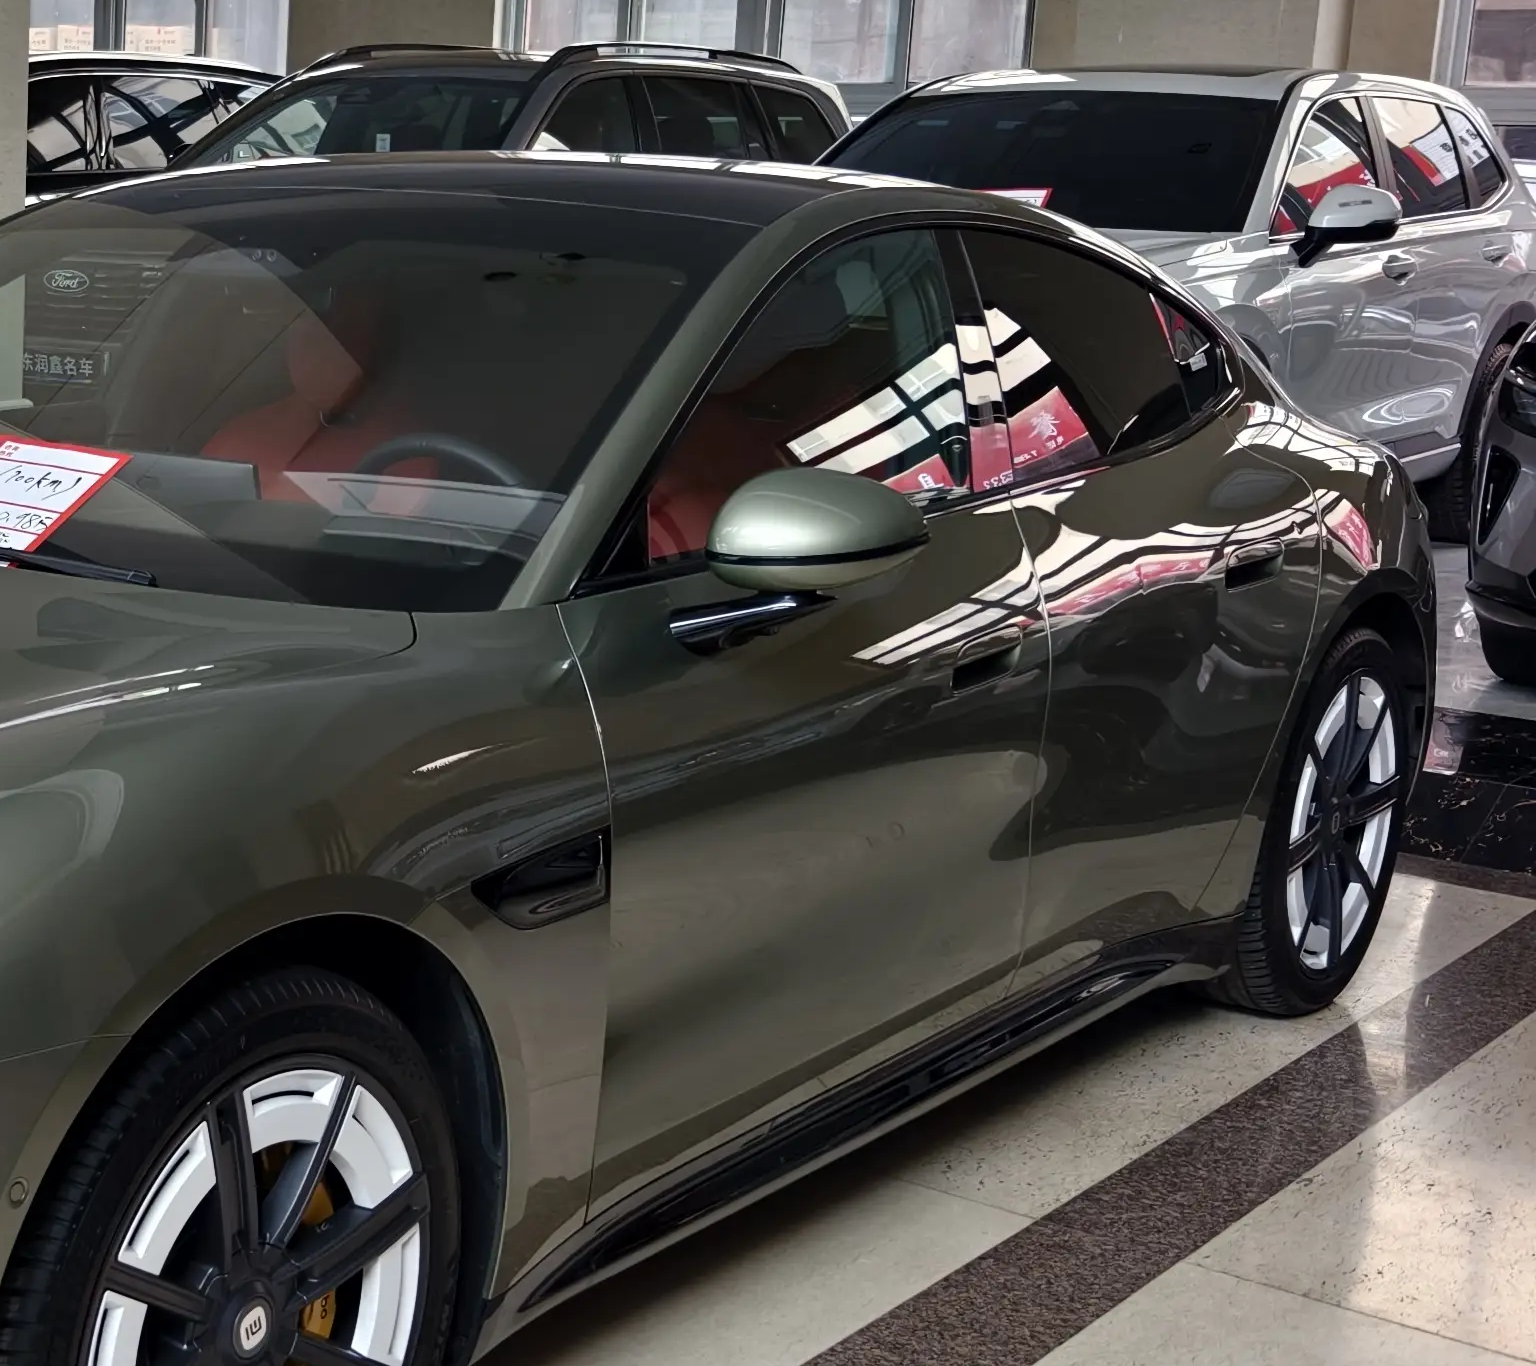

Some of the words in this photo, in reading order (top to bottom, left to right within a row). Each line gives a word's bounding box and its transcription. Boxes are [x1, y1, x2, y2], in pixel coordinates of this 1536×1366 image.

[22, 352, 94, 377] 东润鑫名车
